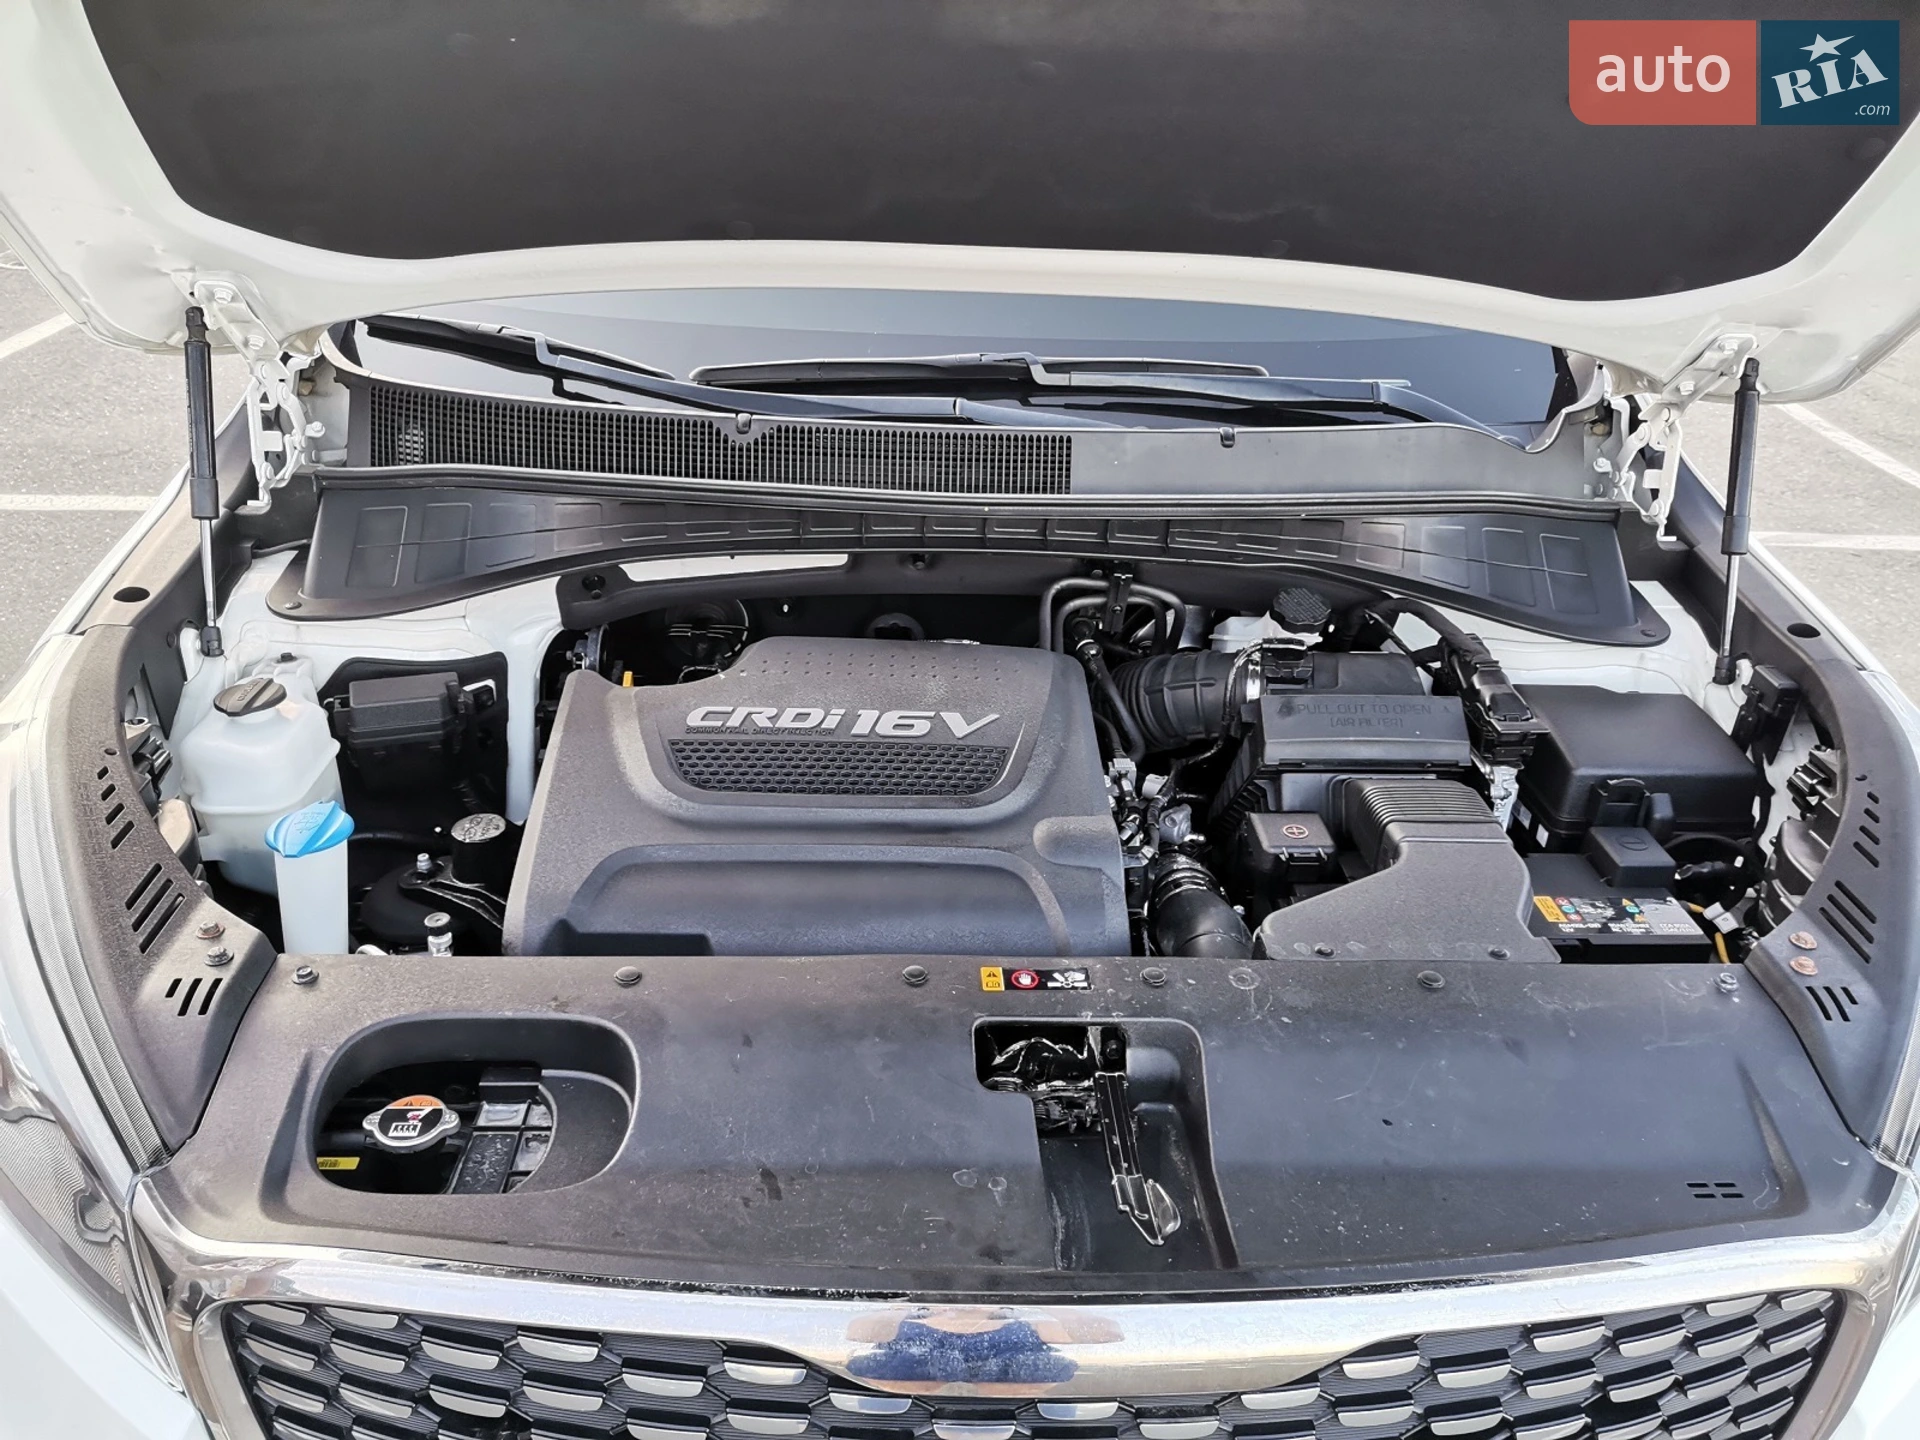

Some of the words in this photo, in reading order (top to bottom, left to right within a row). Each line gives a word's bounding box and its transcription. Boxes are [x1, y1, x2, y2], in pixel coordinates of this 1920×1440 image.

[1297, 703, 1334, 715] PULL
[1337, 703, 1366, 715] OUT
[1372, 703, 1390, 715] TO
[1393, 703, 1432, 715] OPEN
[686, 706, 847, 730] CRDi
[851, 709, 1000, 739] 16V
